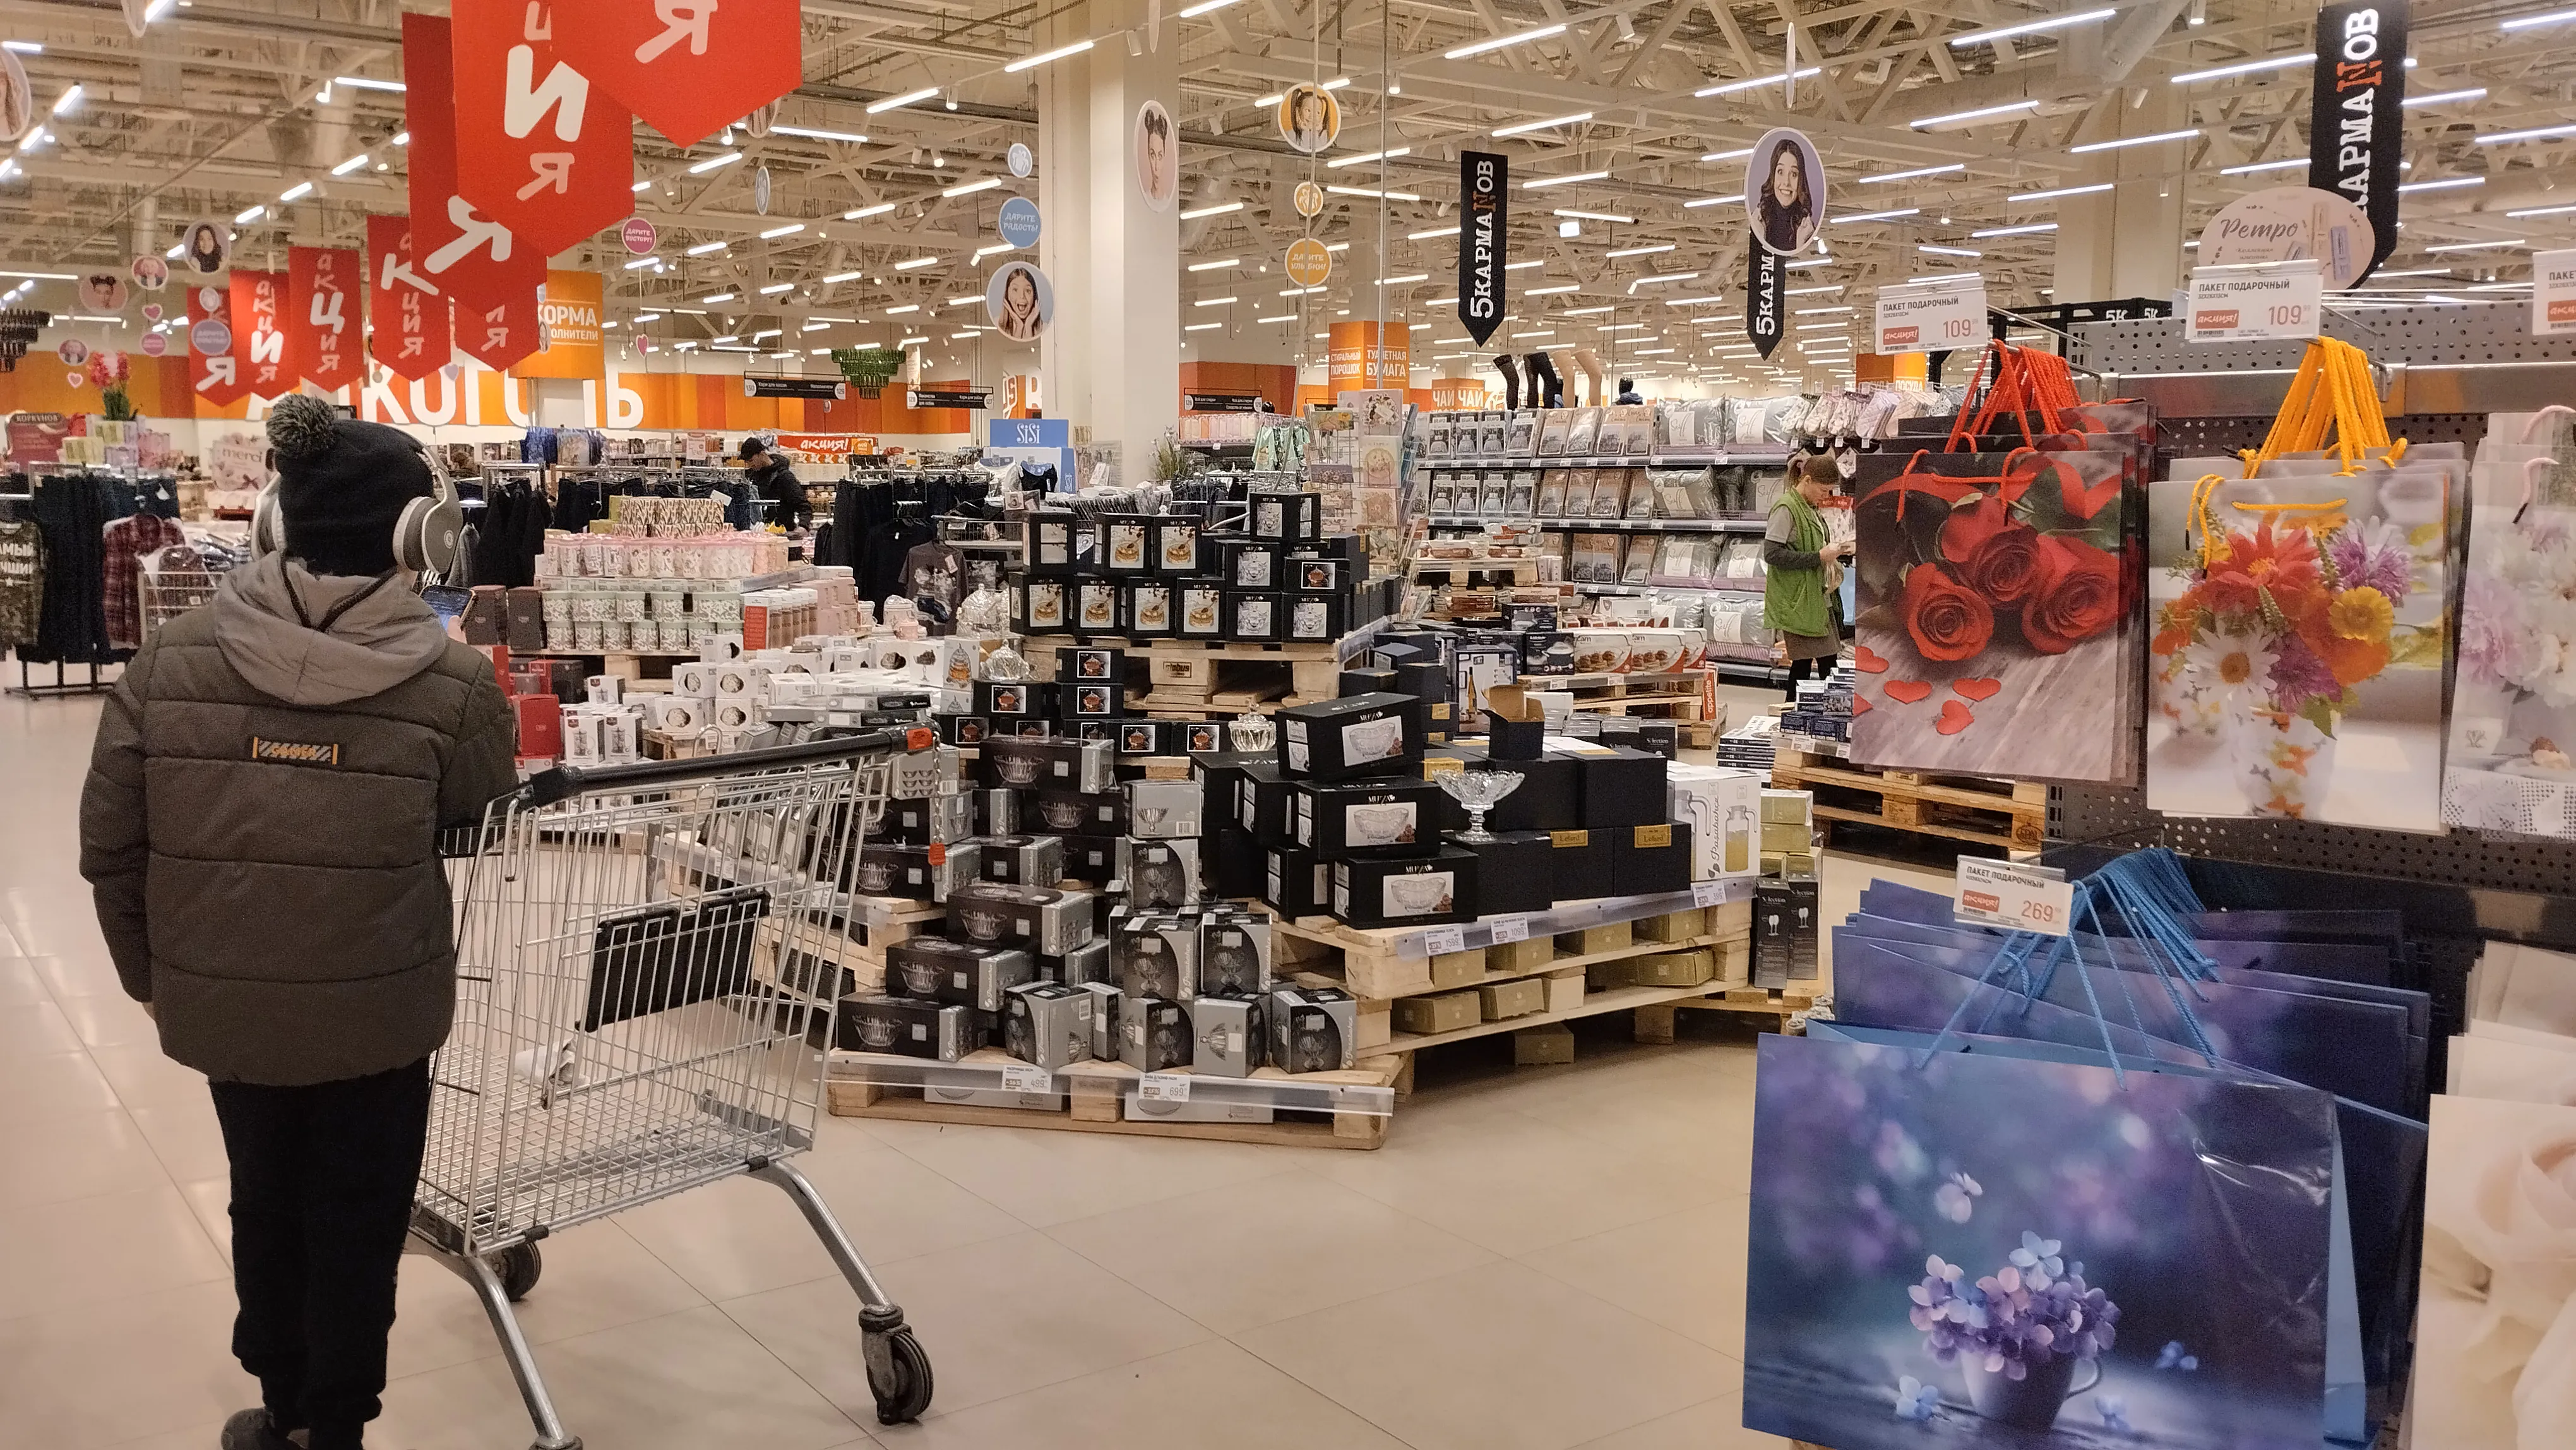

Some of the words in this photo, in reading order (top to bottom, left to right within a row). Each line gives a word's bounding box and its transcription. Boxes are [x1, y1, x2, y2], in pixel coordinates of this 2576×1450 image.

[2220, 218, 2299, 243] Ретро
[1292, 253, 1325, 263] ДАИТЕ
[2549, 270, 2576, 281] ПАКЕ
[2199, 282, 2226, 292] ПАКЕТ
[2227, 279, 2291, 291] ПОДАРОЧНЫЙ
[1883, 302, 1905, 311] ПАКЕТ
[1907, 296, 1959, 309] ПОДАРОЧНЫЙ
[2197, 313, 2238, 324] акция!
[2269, 305, 2301, 326] 109
[1884, 328, 1918, 340] акция!
[1943, 318, 1971, 339] 109
[1366, 349, 1407, 362] ТУАЕТНАЯ
[1330, 362, 1361, 375] ПОРОШОК
[801, 438, 849, 452] акция!
[222, 448, 263, 463] merci
[1967, 866, 1990, 878] ПАКЕТ
[1991, 871, 2045, 889] ПОДАРОЧНЫЙ
[2021, 900, 2053, 922] 269
